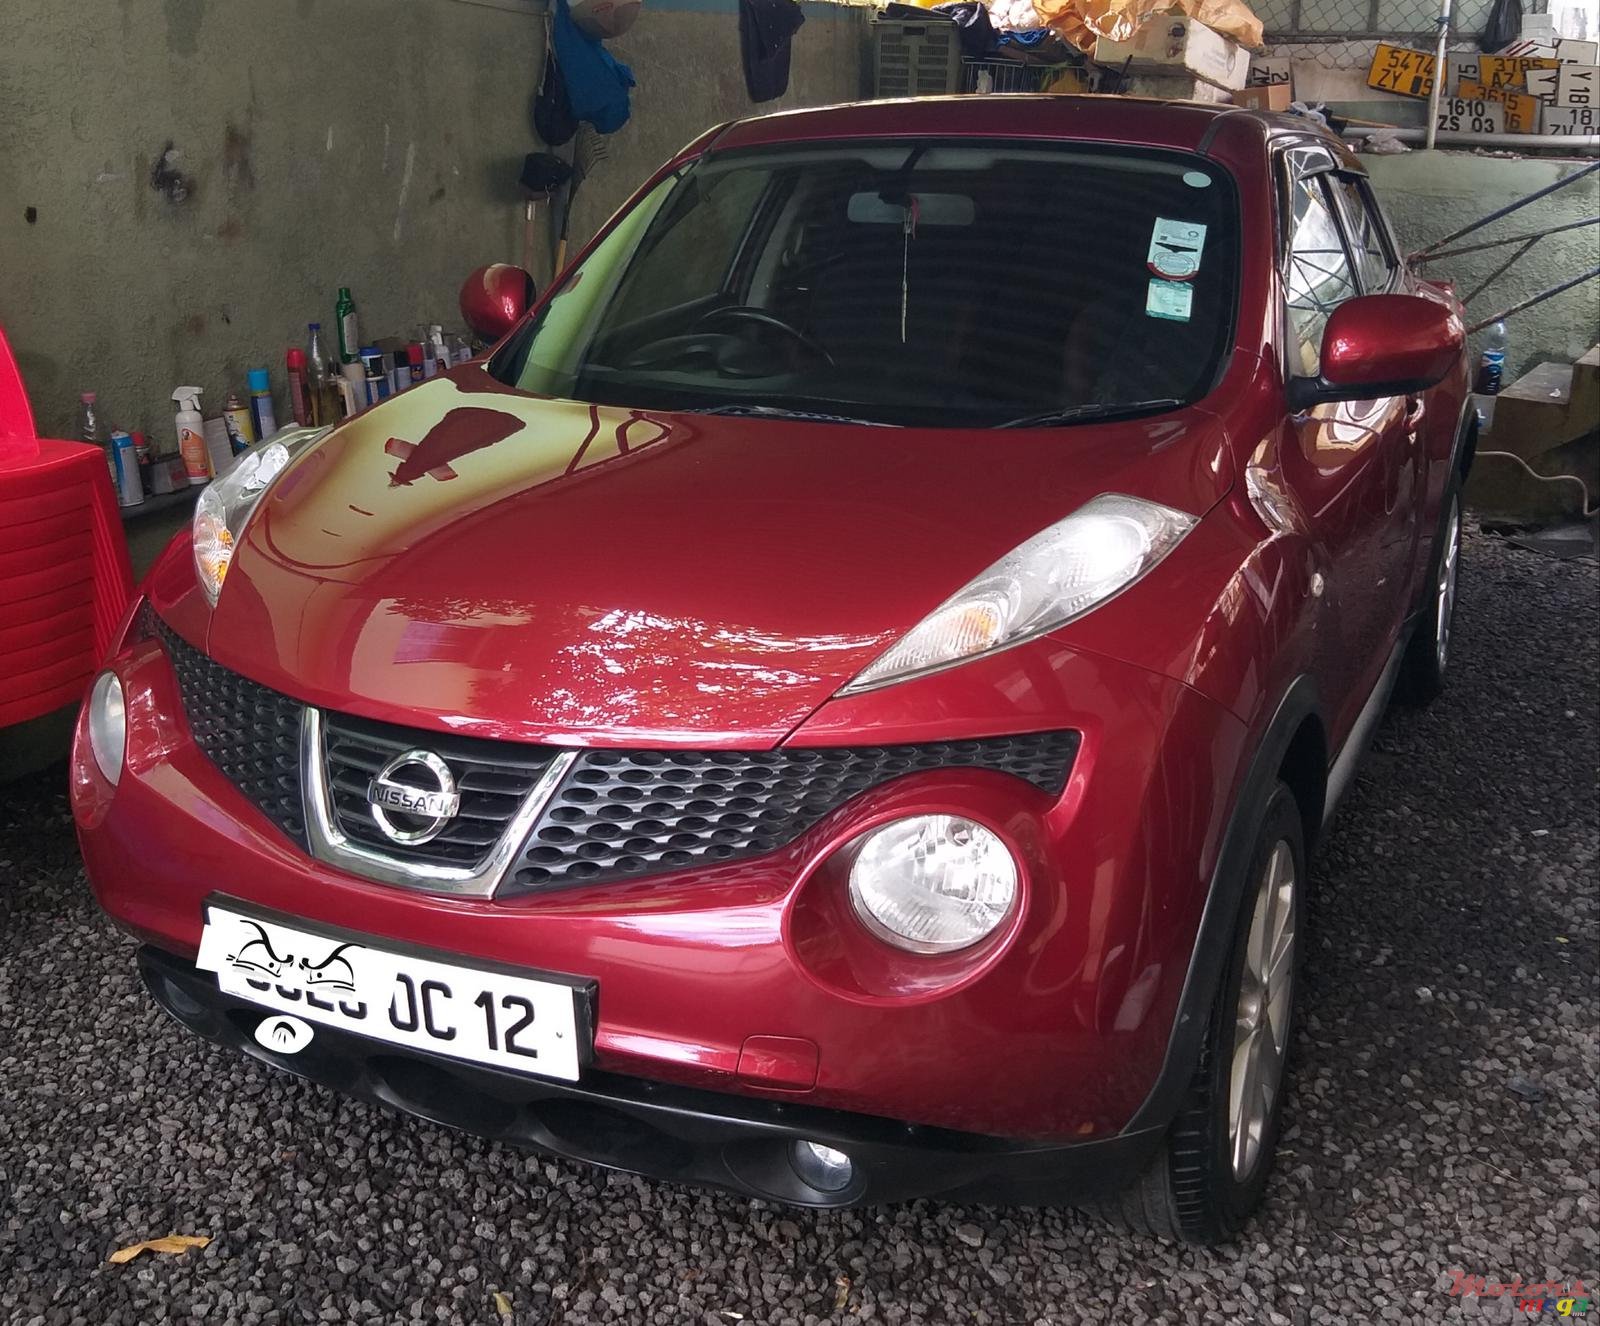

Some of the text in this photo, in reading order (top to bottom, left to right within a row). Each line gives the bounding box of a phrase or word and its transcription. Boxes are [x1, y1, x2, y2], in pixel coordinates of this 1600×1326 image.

[1388, 49, 1435, 76] 5474
[1377, 68, 1403, 90] ZY
[1447, 98, 1485, 118] 1610
[1570, 109, 1592, 125] 18
[1437, 115, 1495, 133] ZS 03
[373, 788, 445, 812] NISSAN
[474, 990, 539, 1059] 12
